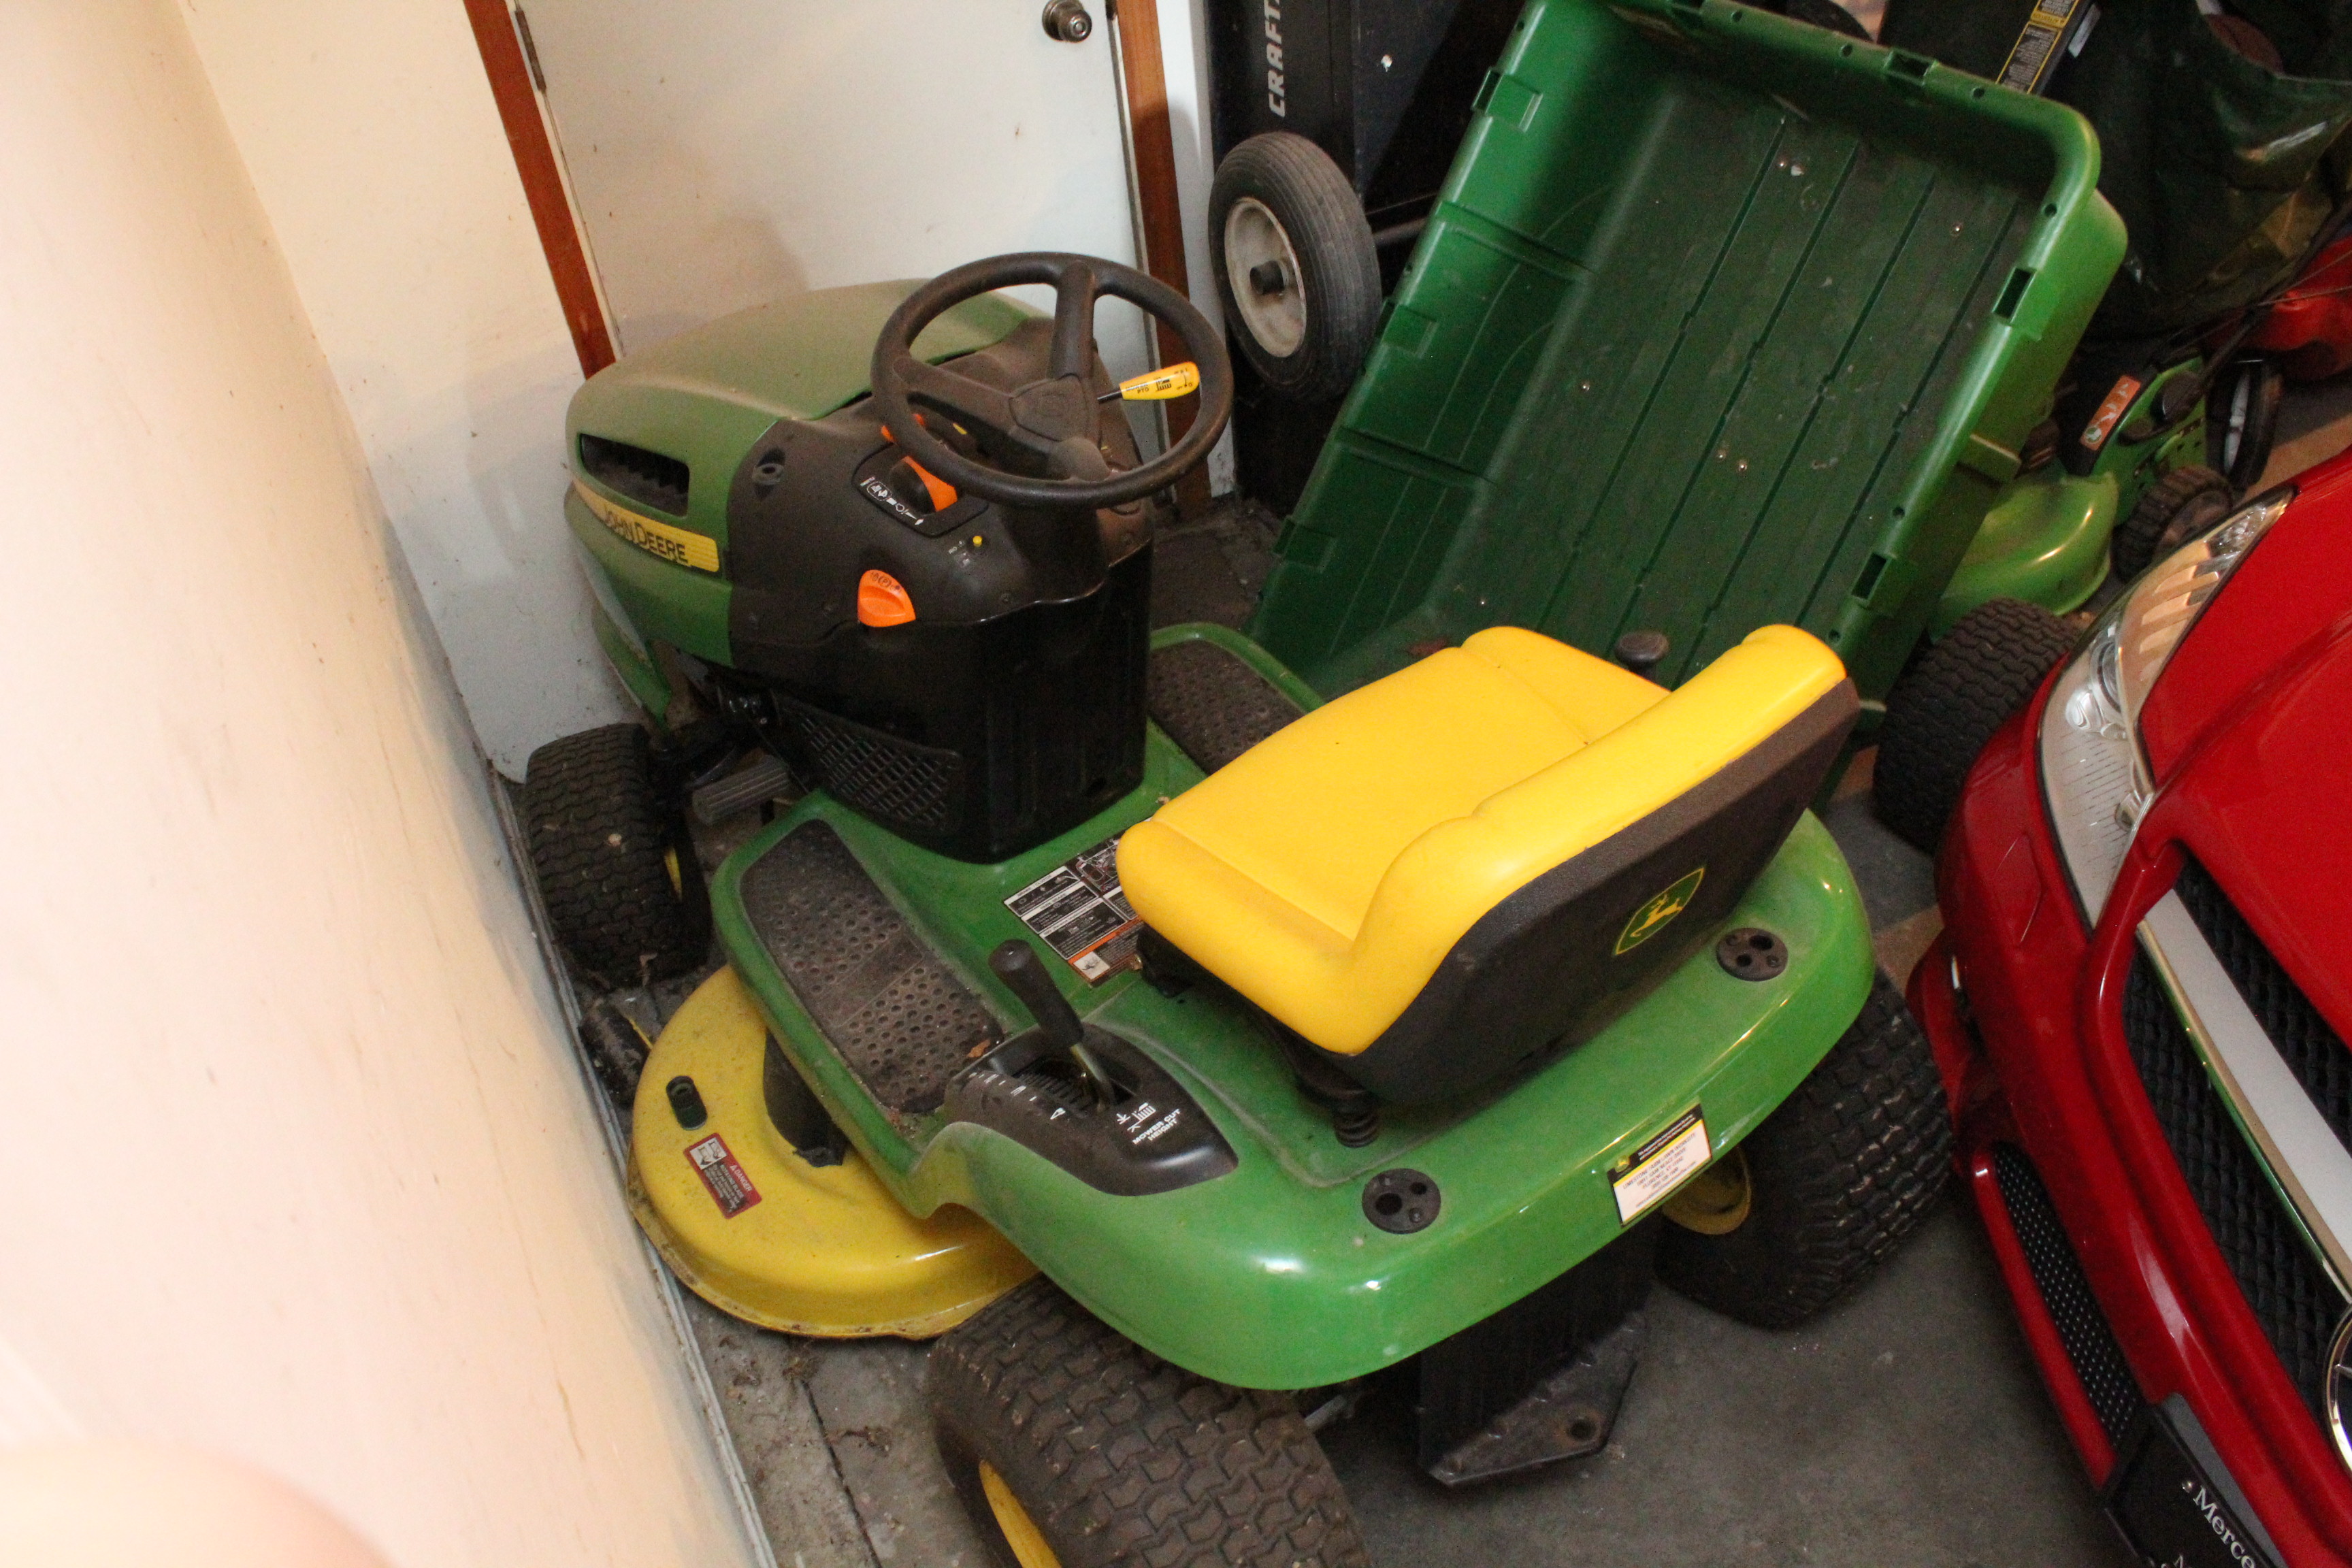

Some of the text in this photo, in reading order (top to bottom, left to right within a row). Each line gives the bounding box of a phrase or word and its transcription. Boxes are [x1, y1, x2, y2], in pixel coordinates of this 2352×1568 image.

[1264, 0, 1286, 118] CRAFT
[604, 502, 689, 564] JOHN DEERE
[1132, 1109, 1181, 1145] MOWER CUT
[1147, 1118, 1177, 1141] HEIGHT
[734, 1169, 753, 1192] DANGER
[2193, 1485, 2255, 1568] Merce
